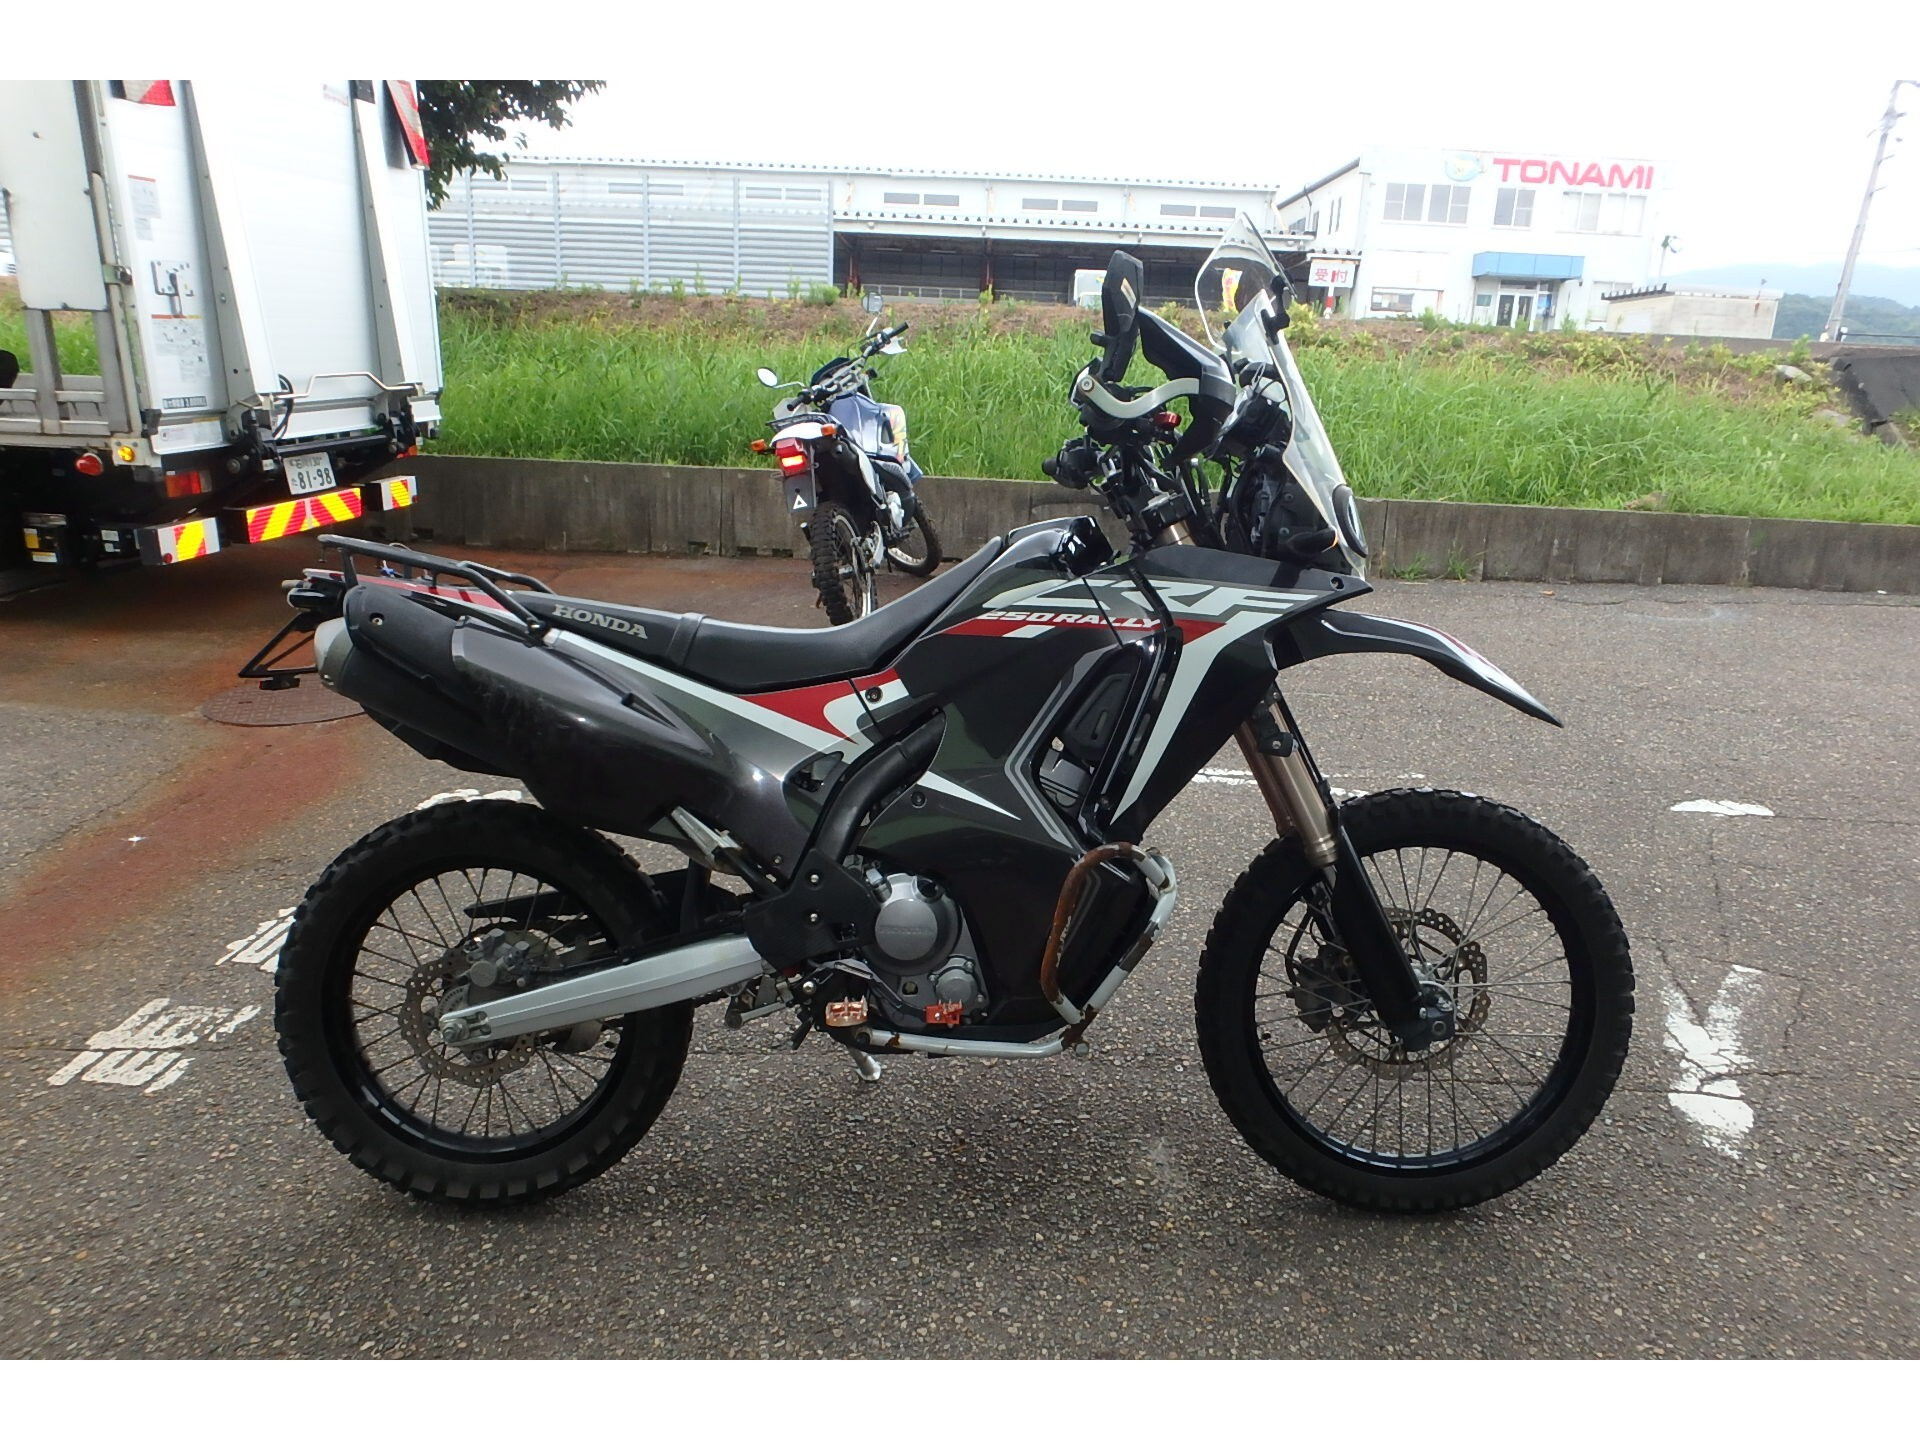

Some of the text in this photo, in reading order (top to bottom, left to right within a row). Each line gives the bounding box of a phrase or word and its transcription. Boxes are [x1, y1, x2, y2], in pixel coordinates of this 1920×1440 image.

[1493, 158, 1654, 190] TONAMI
[1314, 268, 1348, 283] 受付
[552, 604, 648, 640] HONDA
